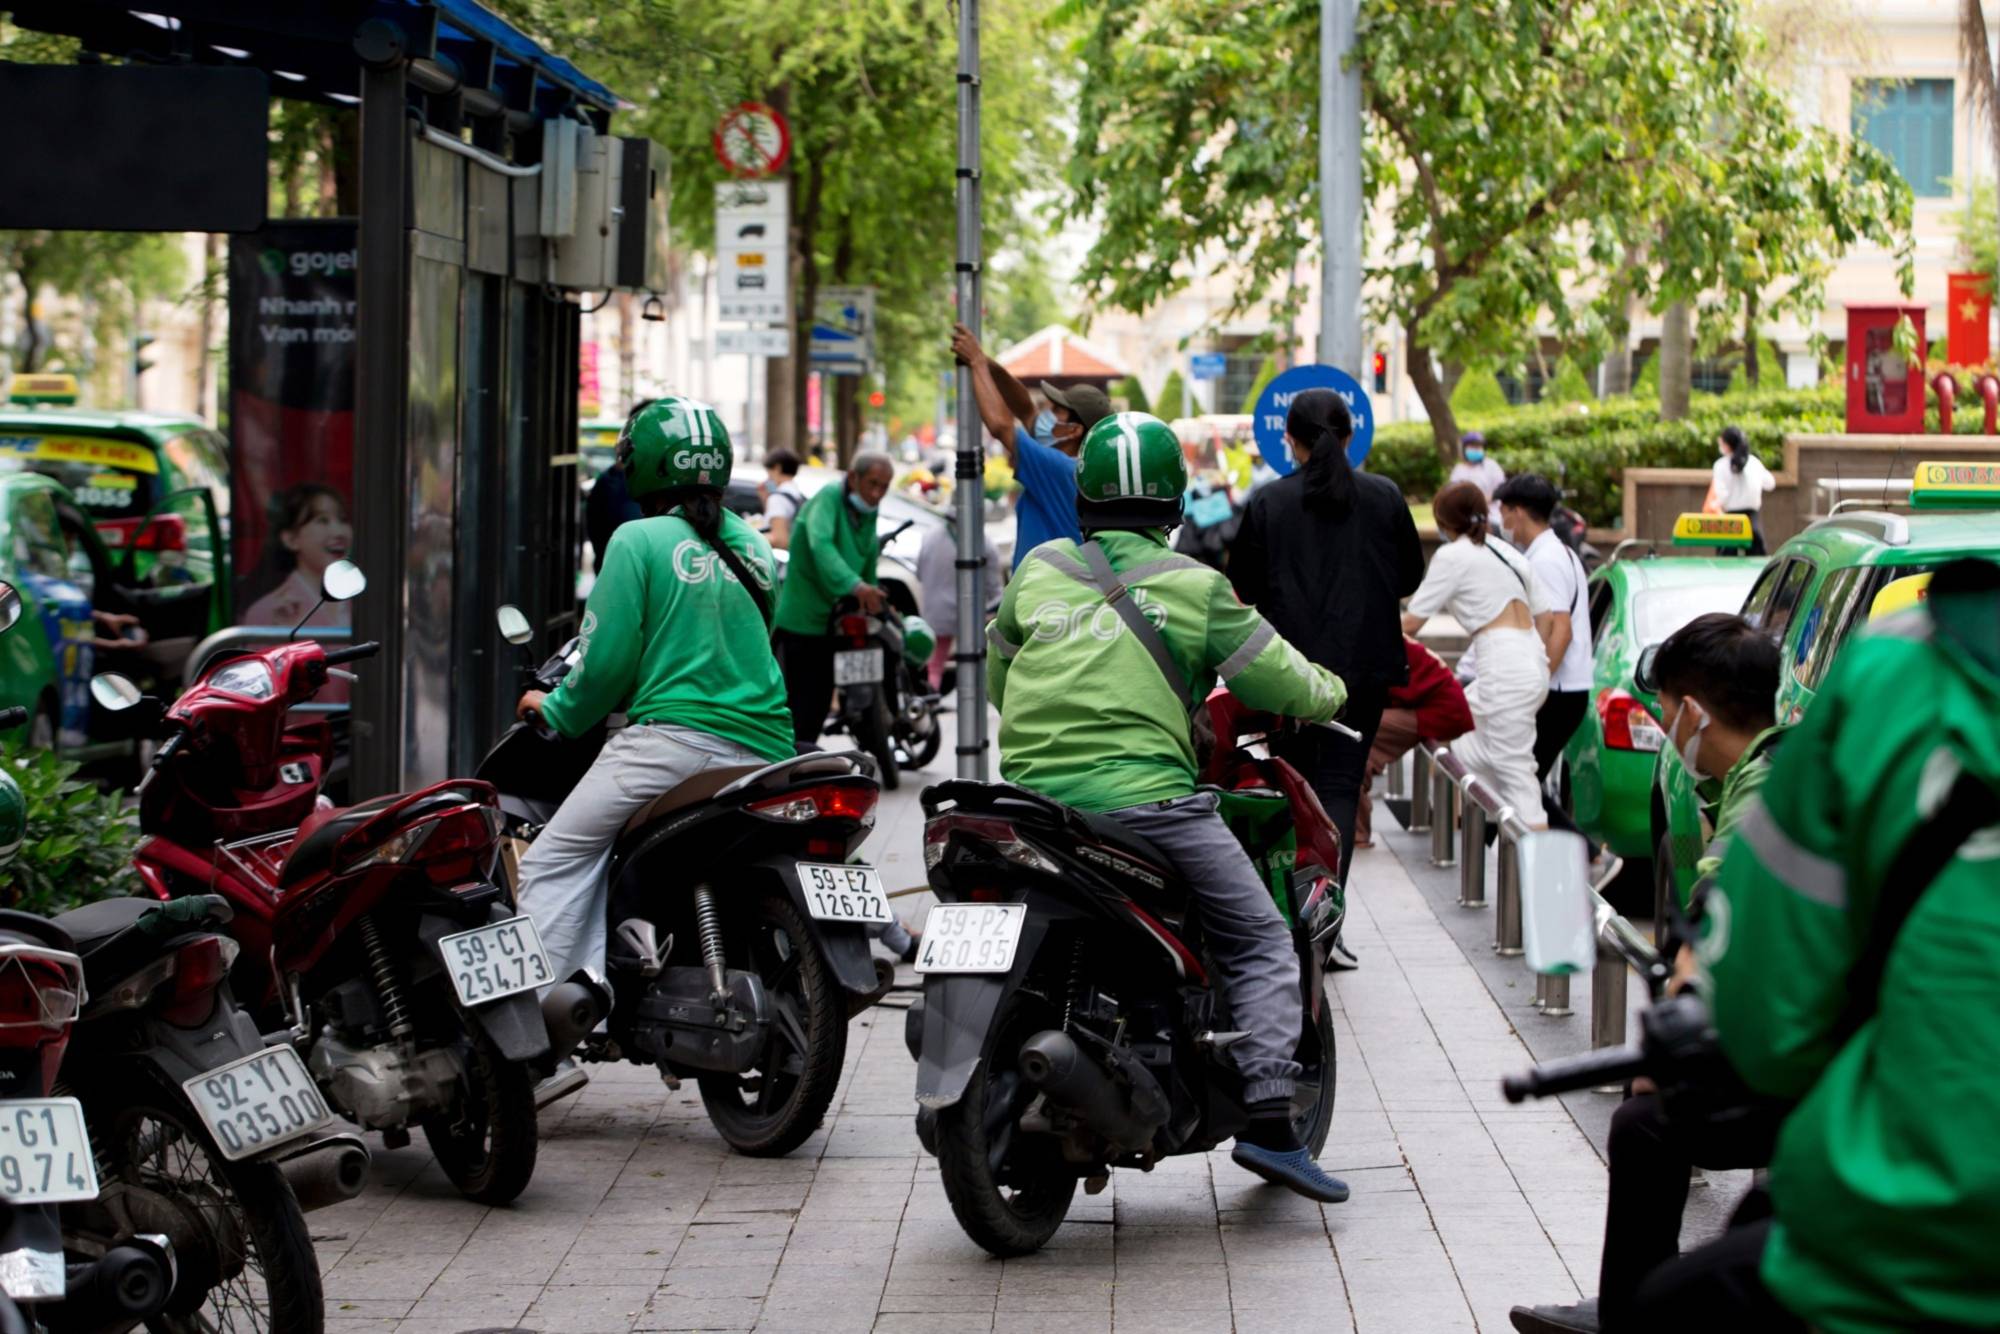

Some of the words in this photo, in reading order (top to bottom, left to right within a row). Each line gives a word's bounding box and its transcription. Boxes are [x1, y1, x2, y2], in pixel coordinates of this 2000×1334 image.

[673, 448, 725, 470] Grab
[810, 867, 872, 893] 59-E2
[815, 893, 886, 918] 126.22
[456, 925, 525, 966] 59-C1
[923, 939, 1010, 967] 460.95
[460, 953, 547, 999] 254.73
[205, 1055, 292, 1111] 92-Y1
[217, 1089, 322, 1151] 035.00
